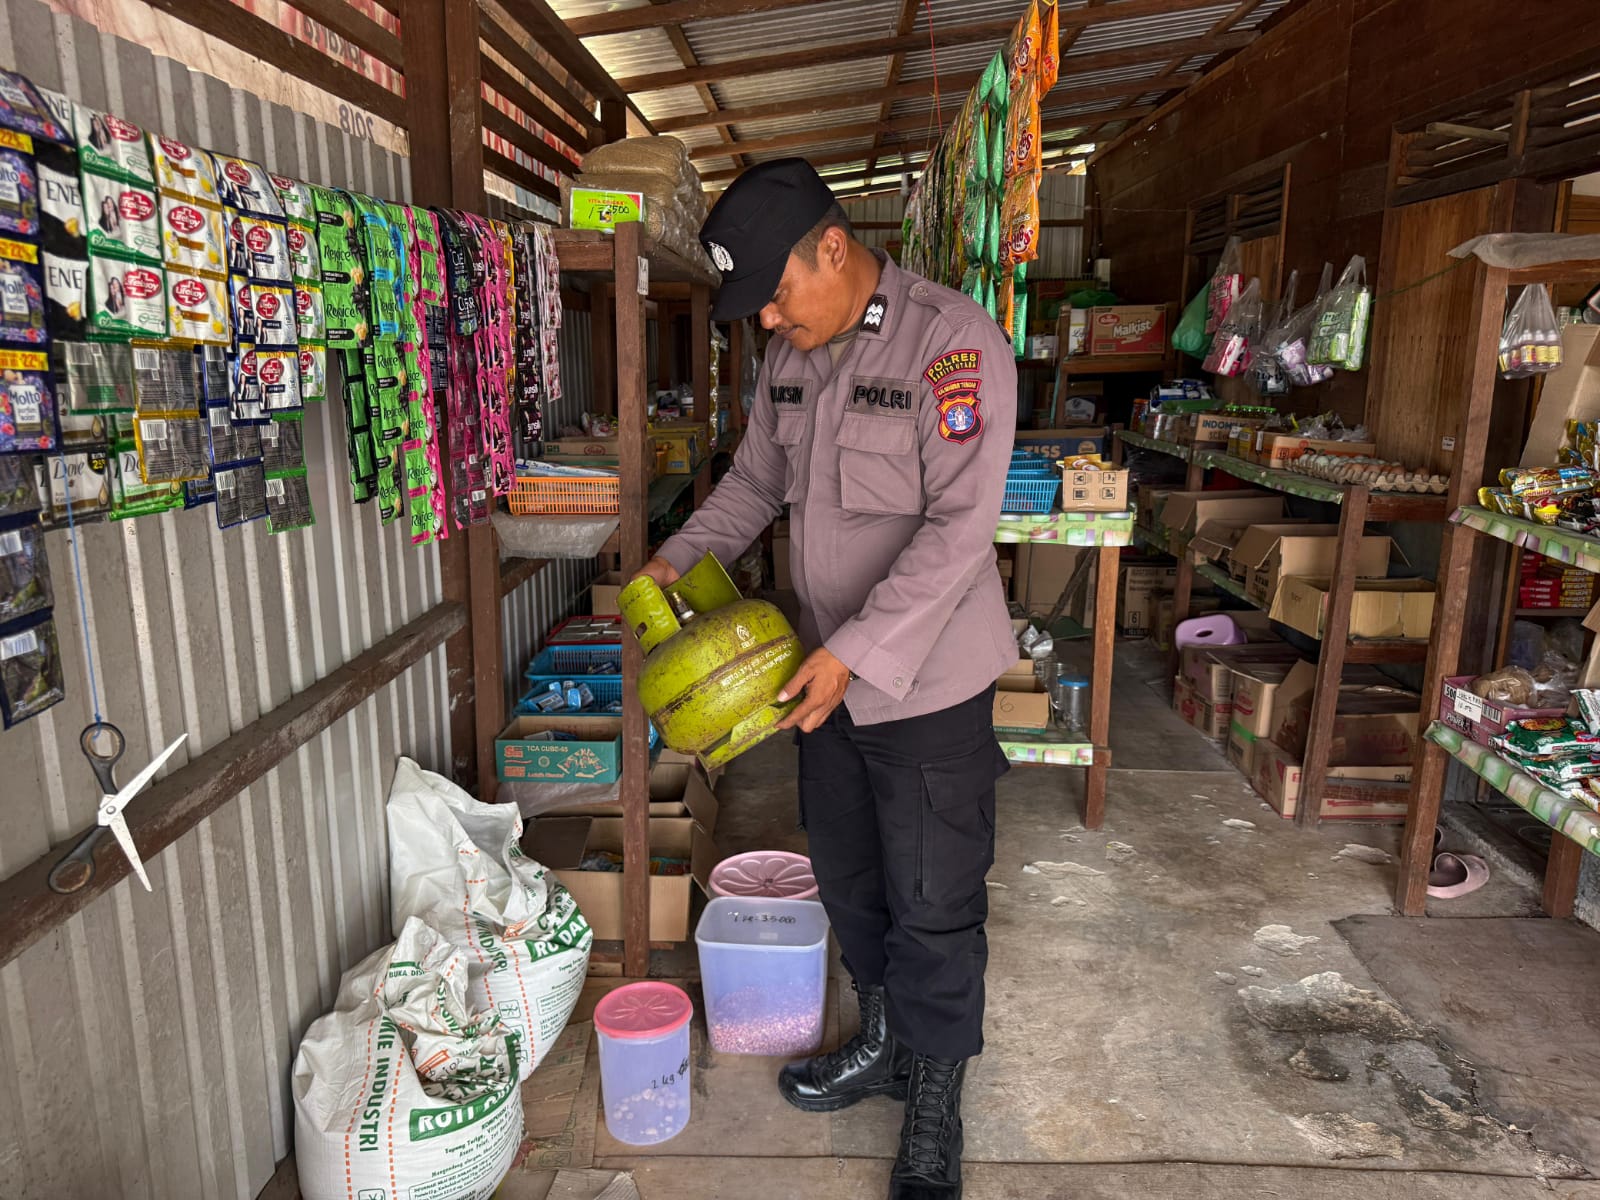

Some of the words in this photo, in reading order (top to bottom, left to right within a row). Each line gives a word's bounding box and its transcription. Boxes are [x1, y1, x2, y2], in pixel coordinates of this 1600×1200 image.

[171, 211, 201, 227] Lifebuoy
[175, 286, 205, 299] Lifebuoy
[1113, 319, 1153, 338] Malkist
[927, 352, 977, 379] POLRES
[9, 391, 41, 406] Molto
[853, 385, 912, 410] POLRI
[53, 458, 85, 480] Dove
[388, 969, 408, 978] BUKA
[377, 1015, 397, 1051] MIE
[359, 1057, 391, 1152] INDUSTRI
[418, 1105, 475, 1133] ROTI
[445, 1143, 466, 1154] Tepung
